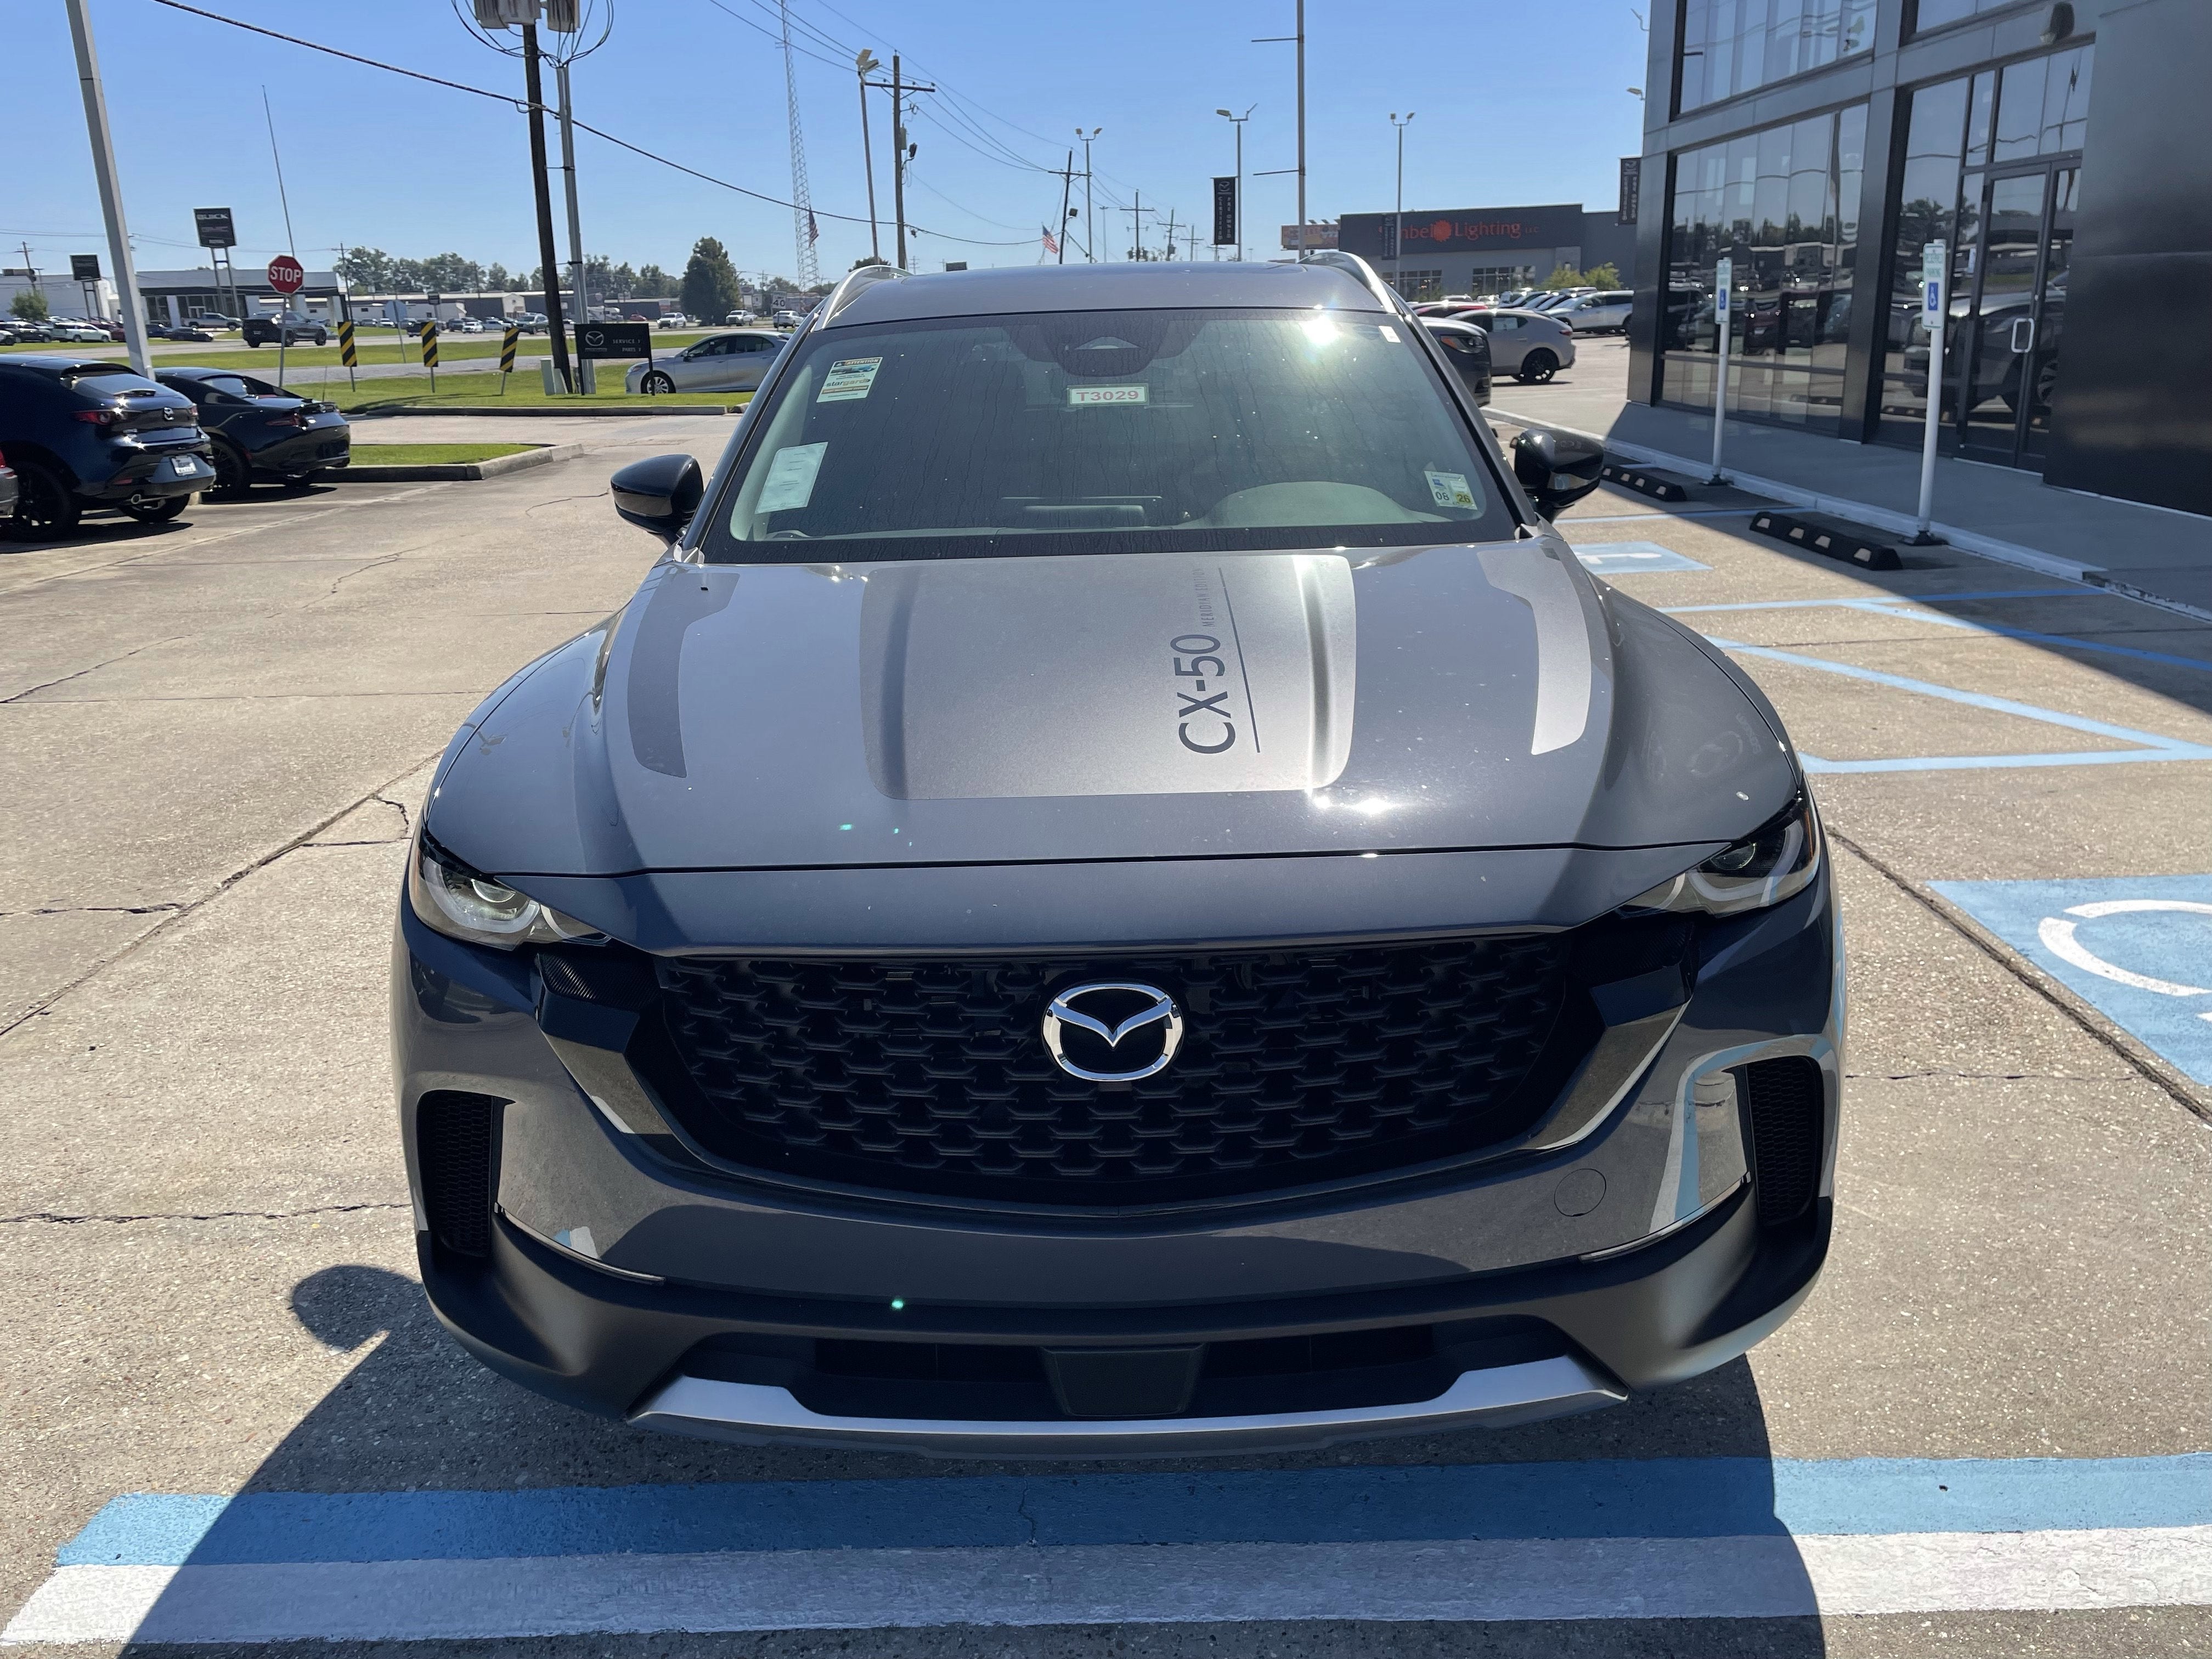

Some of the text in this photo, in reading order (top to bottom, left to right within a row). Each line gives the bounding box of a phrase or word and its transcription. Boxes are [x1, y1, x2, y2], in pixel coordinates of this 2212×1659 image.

[1455, 221, 1520, 240] Lighting
[270, 266, 302, 283] STOP
[1076, 391, 1139, 402] T3029
[1435, 492, 1471, 503] 08 26
[1197, 593, 1215, 627] MERIDIAN
[1170, 634, 1235, 754] CX-50
